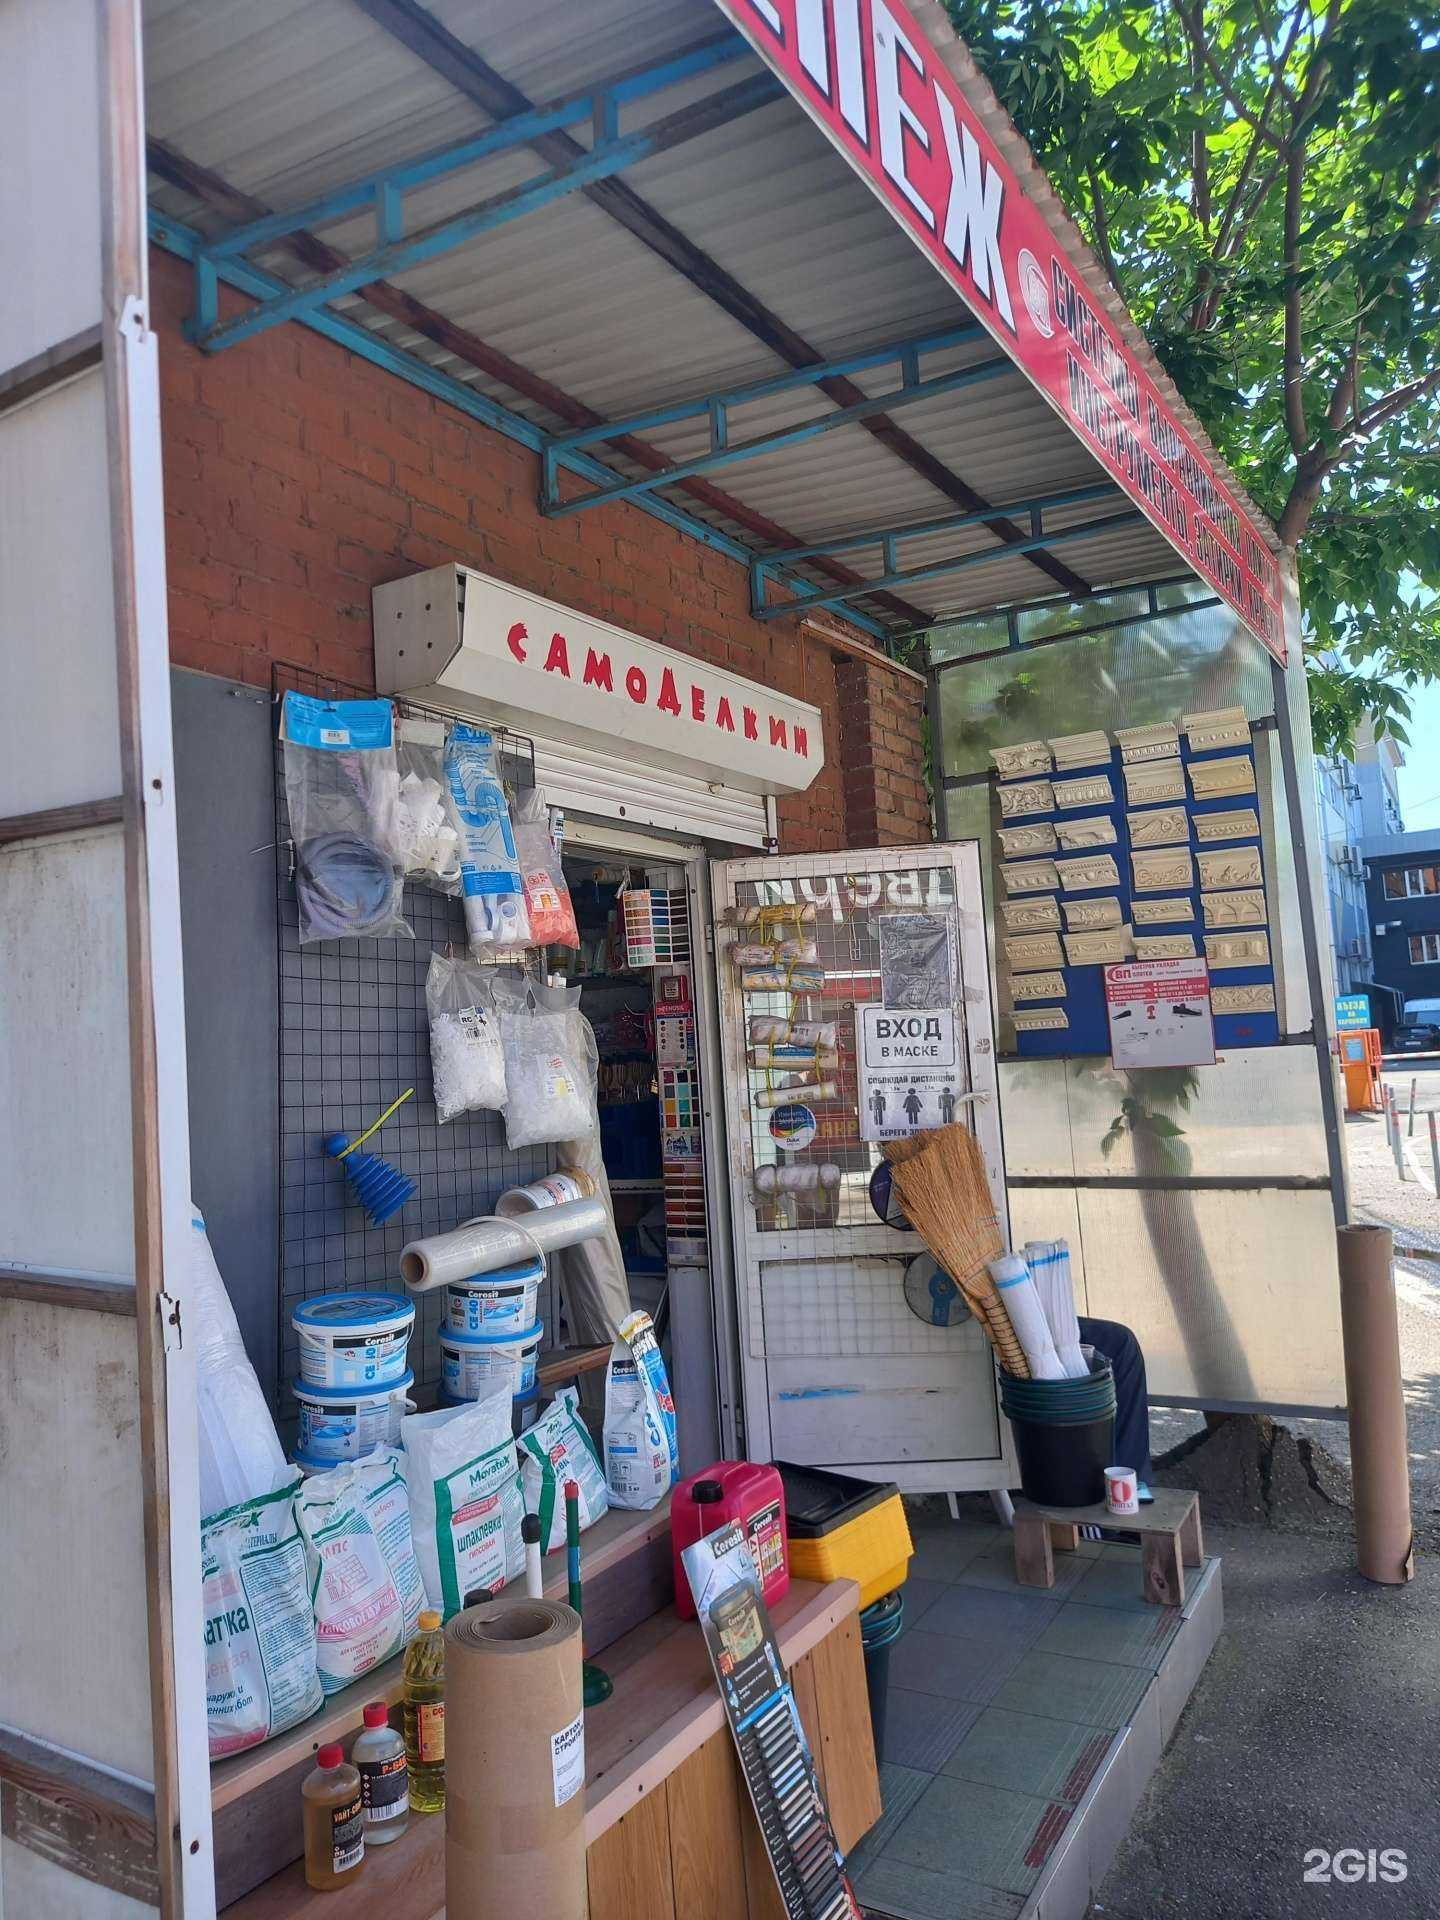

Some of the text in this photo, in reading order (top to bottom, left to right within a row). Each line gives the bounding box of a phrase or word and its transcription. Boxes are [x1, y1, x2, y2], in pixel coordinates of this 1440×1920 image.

[1050, 255, 1142, 428] СИСТЕМЫ
[506, 621, 809, 760] САМОДЕЛКИН
[876, 1017, 942, 1041] ВХОД
[881, 1045, 939, 1058] В МАСКЕ
[867, 1074, 909, 1085] СОБЛЮДАЙ
[879, 1128, 907, 1137] БЕРЕГИ
[467, 1289, 500, 1299] Ceresit
[365, 1333, 395, 1347] Ceresit
[457, 1515, 502, 1553] шпаклевка
[714, 1528, 744, 1556] Ceresit
[554, 1719, 582, 1746] КАРТОН
